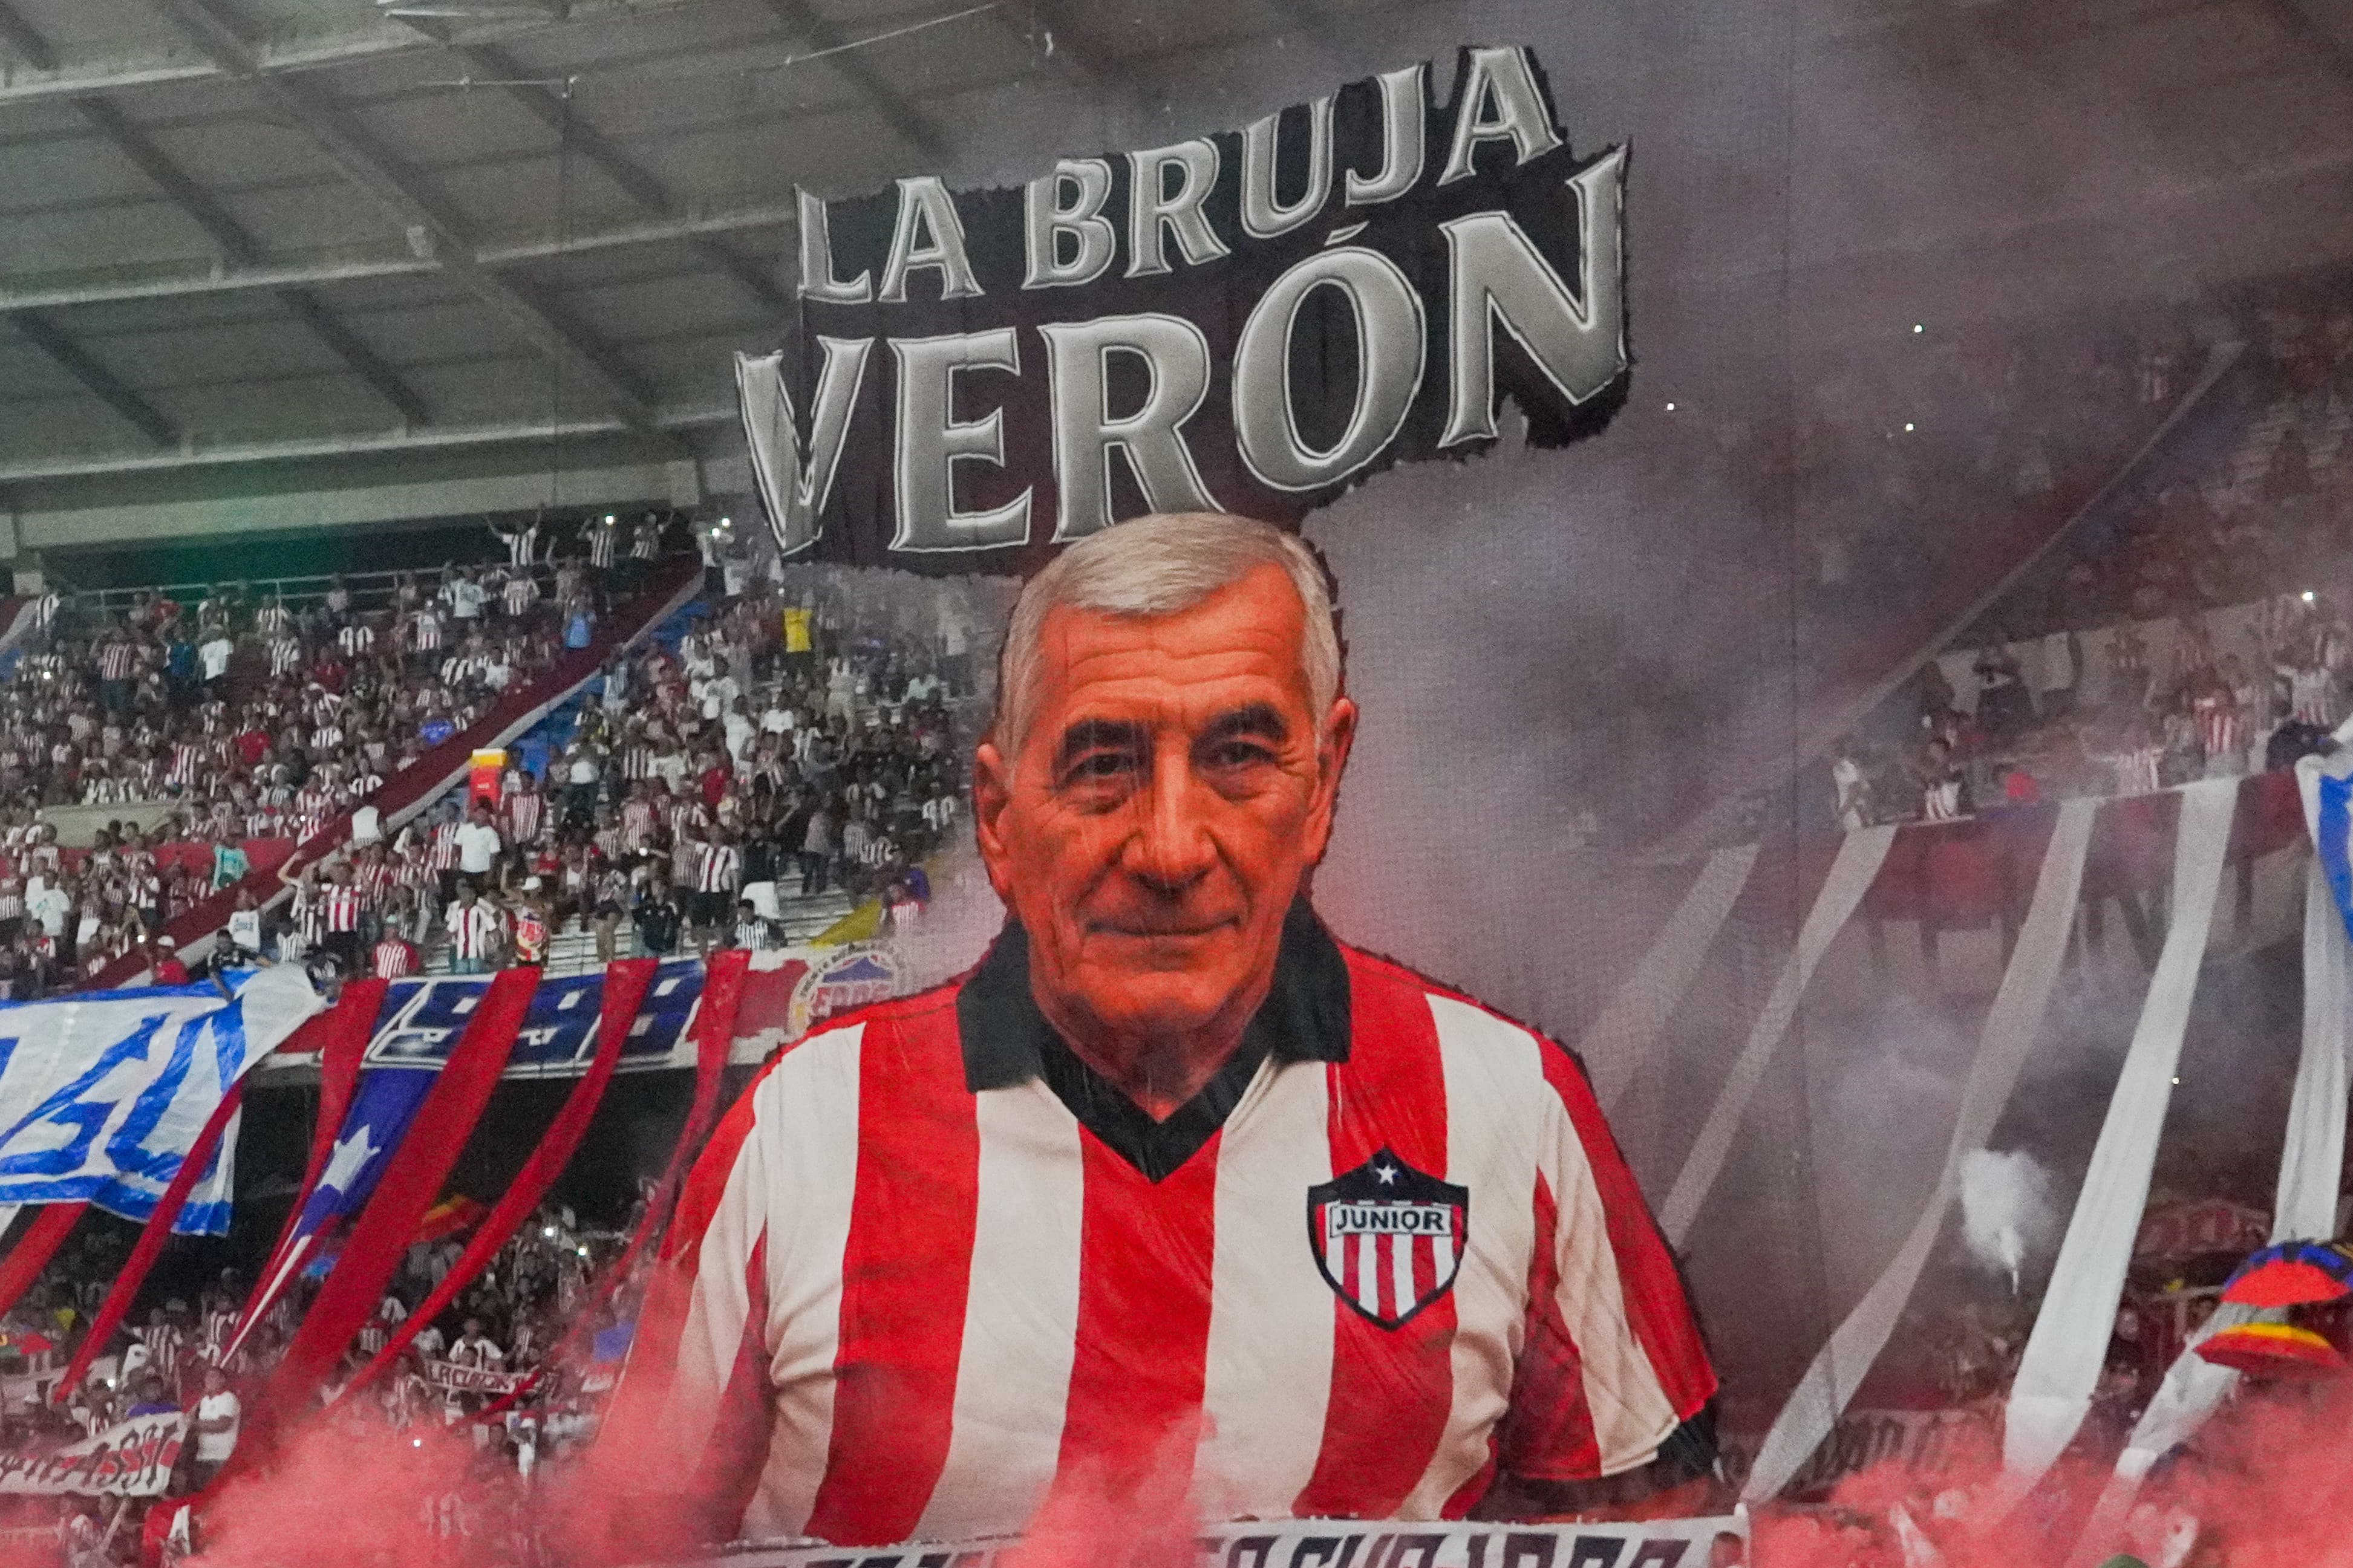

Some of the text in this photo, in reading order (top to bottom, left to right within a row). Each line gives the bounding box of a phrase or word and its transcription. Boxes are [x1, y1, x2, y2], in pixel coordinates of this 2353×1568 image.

[795, 45, 1563, 304] LA BRUJA
[734, 145, 1630, 555] VERÓN
[1336, 1208, 1444, 1232] JUNIOR
